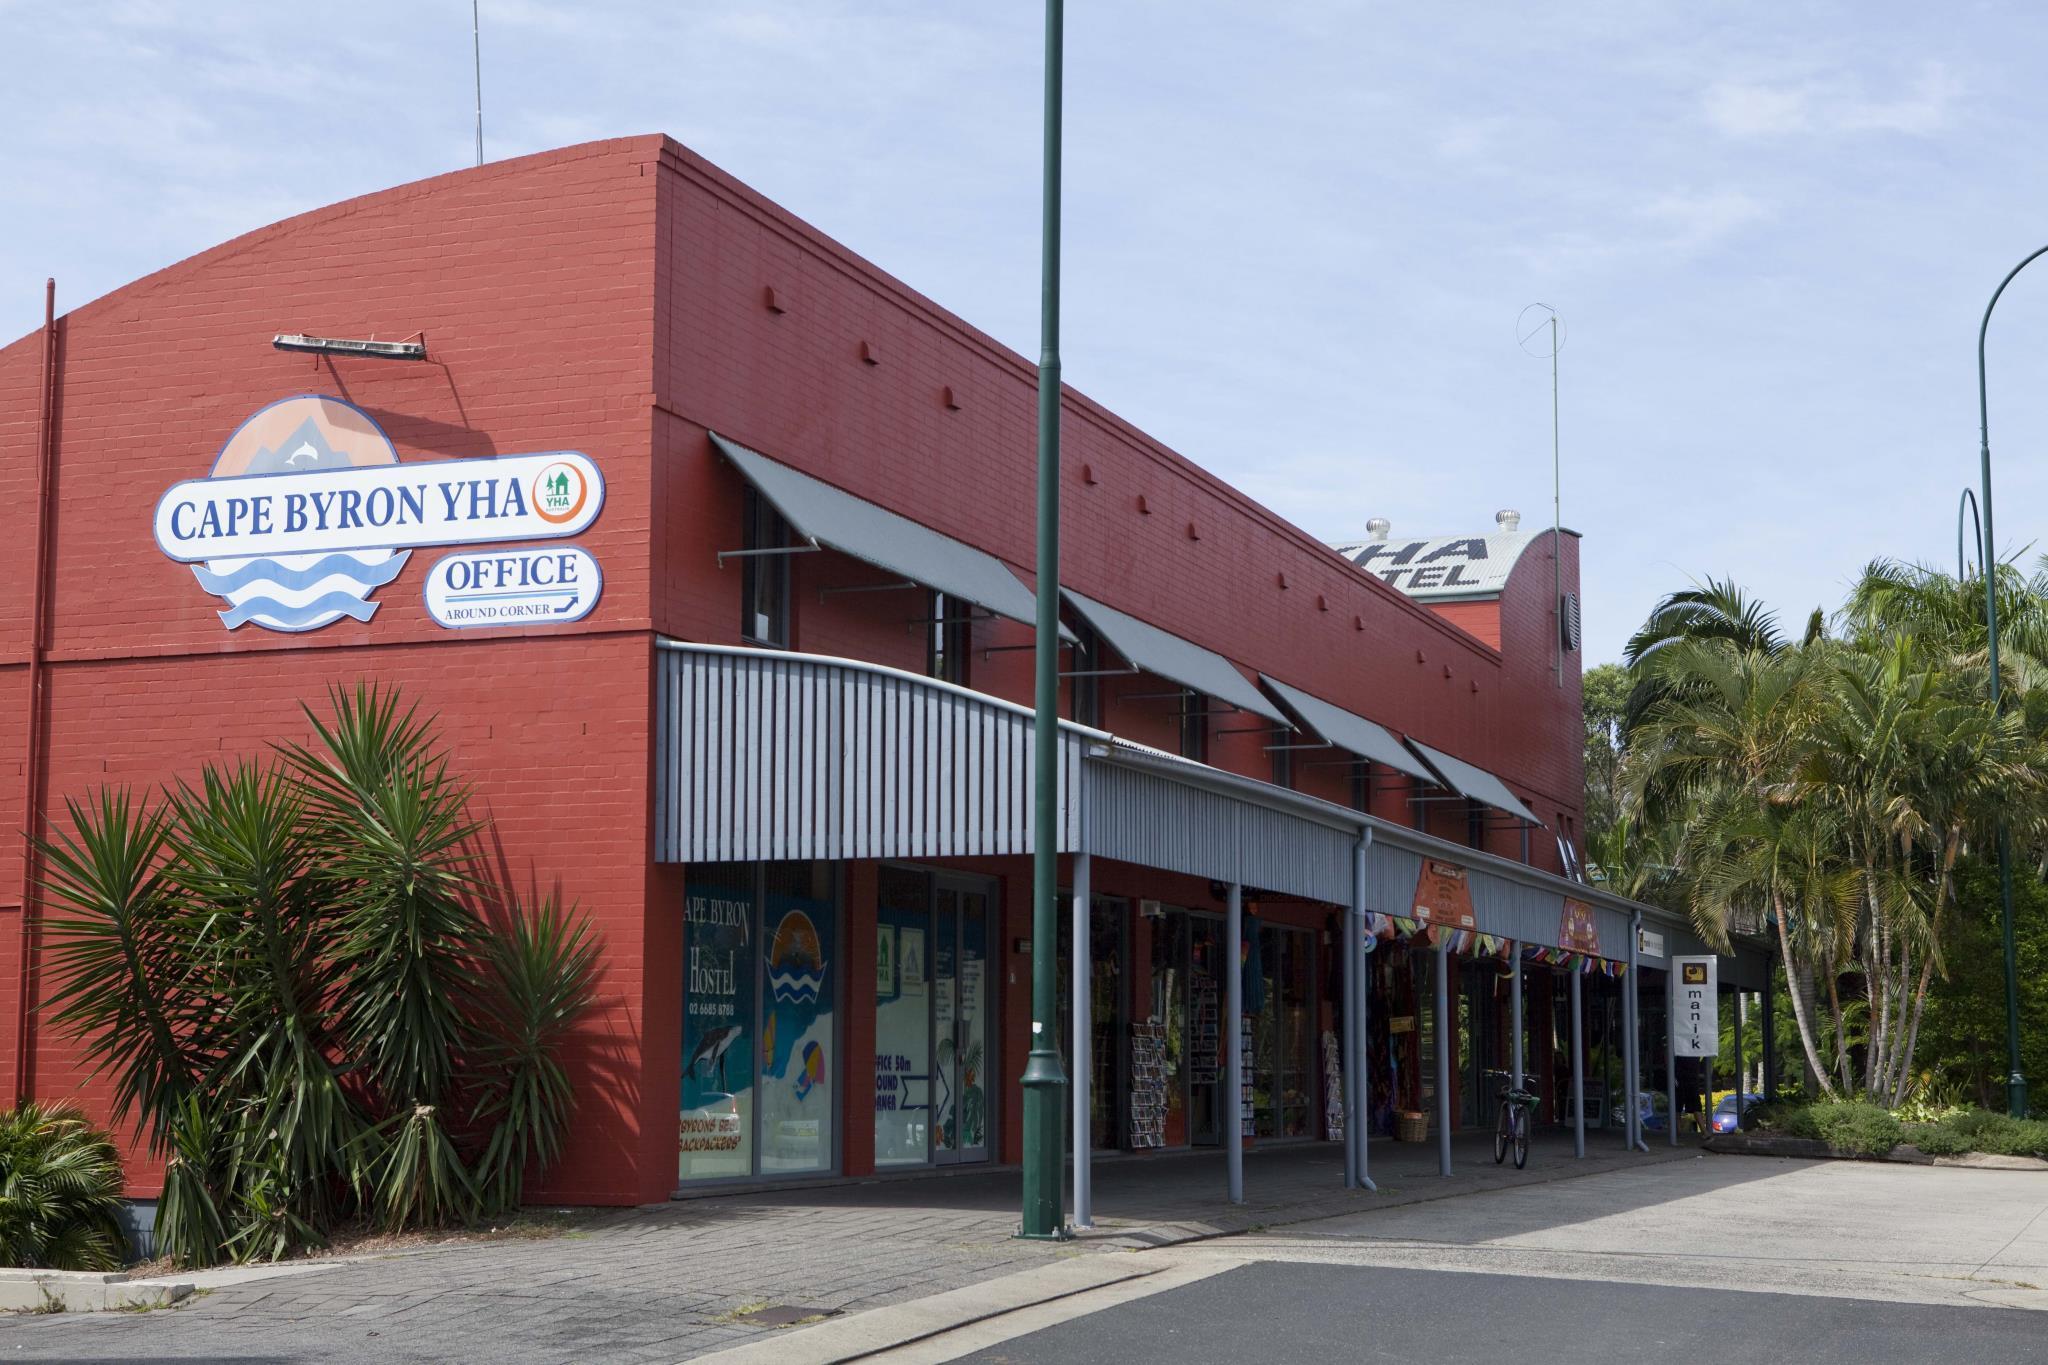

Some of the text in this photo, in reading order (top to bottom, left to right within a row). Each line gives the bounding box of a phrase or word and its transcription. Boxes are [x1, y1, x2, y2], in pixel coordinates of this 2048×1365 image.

[171, 477, 528, 541] CAPE BYRON YHA
[546, 496, 570, 507] YHA
[1337, 538, 1488, 567] HA
[445, 554, 578, 590] OFFICE
[1378, 565, 1479, 588] TEL
[445, 604, 550, 620] AROUND CORNER
[683, 896, 750, 946] APE BYRON
[878, 968, 889, 982] HA
[689, 1003, 698, 1015] 02
[699, 1003, 716, 1015] 6685
[1688, 990, 1702, 1049] manik
[895, 1055, 911, 1071] 50m
[876, 1075, 897, 1091] OUND
[876, 1094, 896, 1111] RNER
